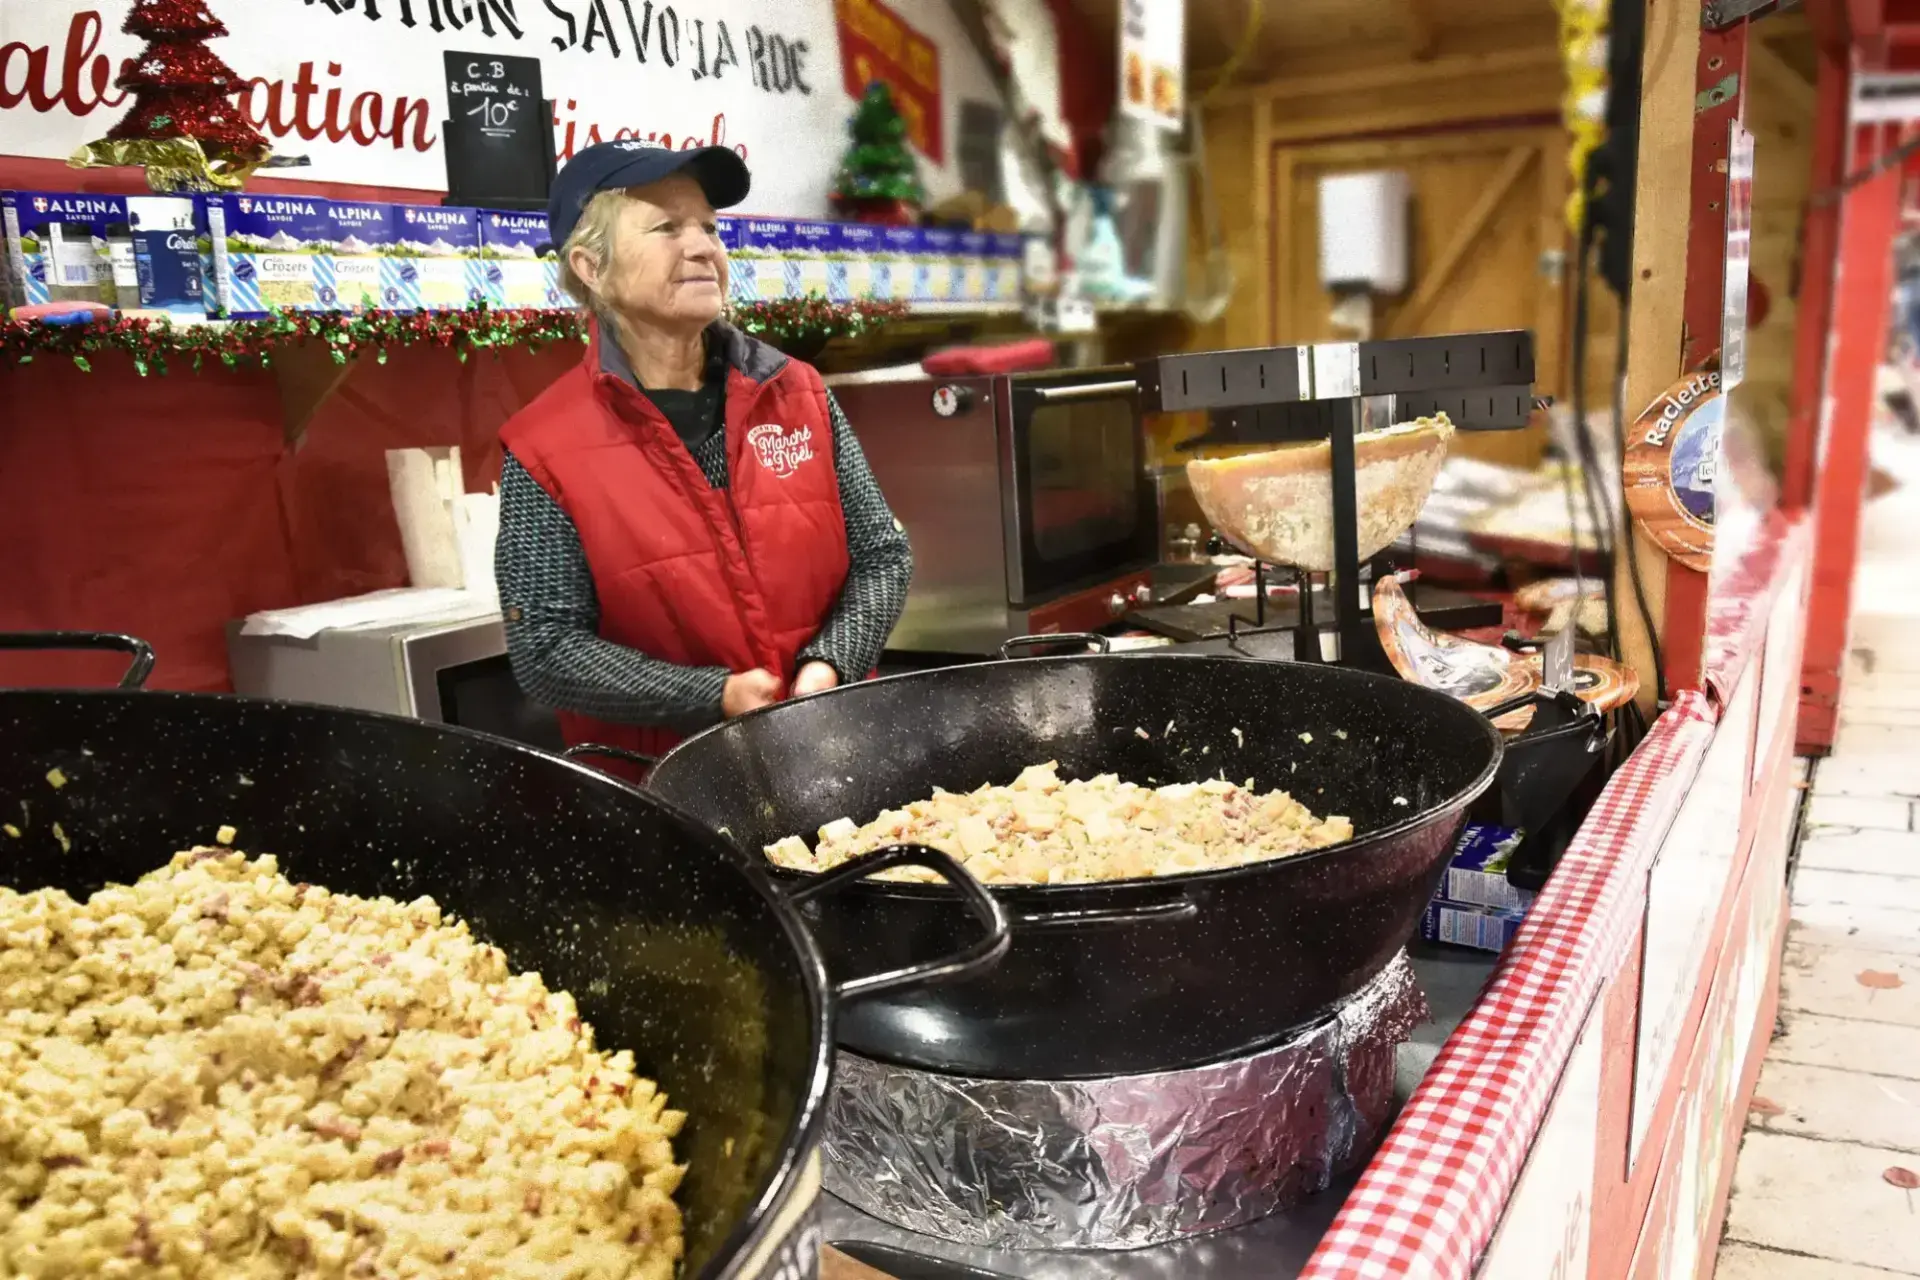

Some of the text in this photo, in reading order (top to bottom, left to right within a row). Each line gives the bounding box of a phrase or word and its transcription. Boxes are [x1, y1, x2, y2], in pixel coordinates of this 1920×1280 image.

[50, 199, 121, 214] ALPINA
[253, 201, 317, 216] ALPINA
[65, 213, 96, 221] SAVOIE
[266, 214, 294, 222] SAVOIE
[328, 207, 383, 221] ALPINA
[416, 211, 468, 225] ALPINA
[501, 216, 548, 229] ALPINA
[755, 222, 787, 233] ALPINA
[262, 258, 308, 273] Crozets
[1644, 371, 1721, 447] Raclette
[758, 423, 812, 456] Marché
[773, 441, 814, 472] Noël
